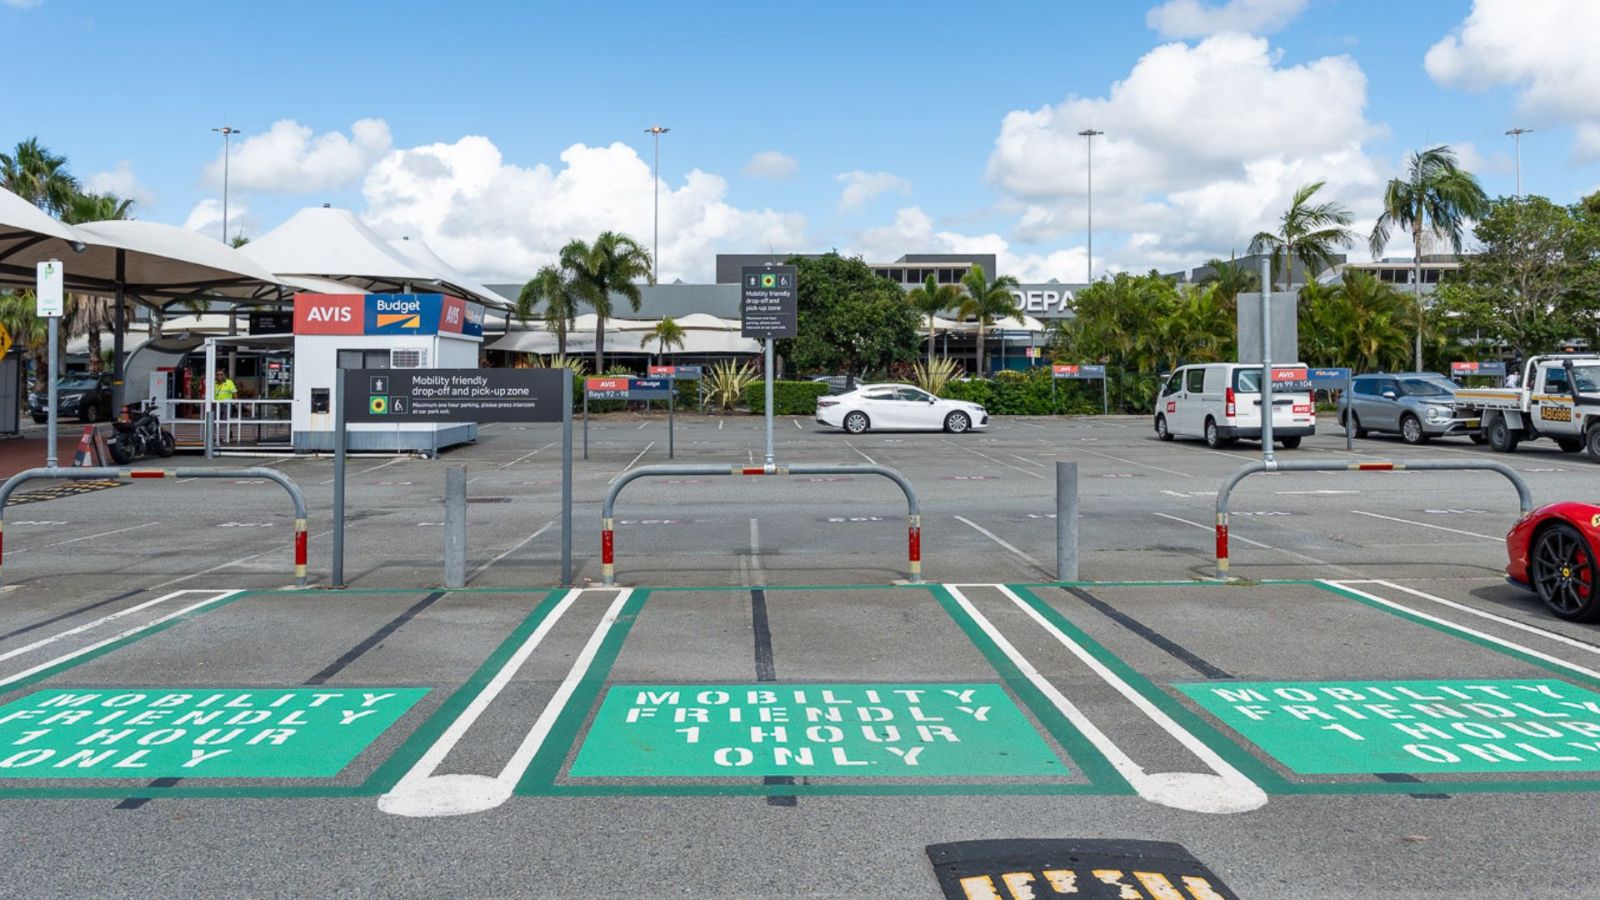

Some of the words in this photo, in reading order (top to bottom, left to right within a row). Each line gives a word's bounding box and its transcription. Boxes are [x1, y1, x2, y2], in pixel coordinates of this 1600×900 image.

[307, 306, 352, 323] AVIS
[376, 300, 421, 315] Budget
[446, 305, 460, 325] AVIS
[412, 376, 450, 389] Mobility
[452, 376, 488, 388] friendly
[412, 387, 450, 397] drop-off
[451, 387, 469, 396] and
[471, 387, 506, 397] pick-up
[507, 388, 530, 396] zone
[588, 390, 605, 399] Bays
[37, 693, 397, 708] MOBILITY
[636, 689, 976, 705] MOBILITY
[1209, 685, 1565, 703] MOBILITY
[0, 710, 377, 725] FRIENDLY
[625, 705, 991, 724] FRIENDLY
[1233, 701, 1600, 721] FRIENDLY
[12, 729, 53, 745] 1
[75, 728, 299, 745] HOUR
[676, 727, 700, 743] 1
[750, 725, 961, 743] HOUR
[1321, 723, 1366, 741] 1
[1391, 721, 1600, 740] HOUR
[0, 749, 233, 768] ONLY
[713, 746, 926, 767] ONLY
